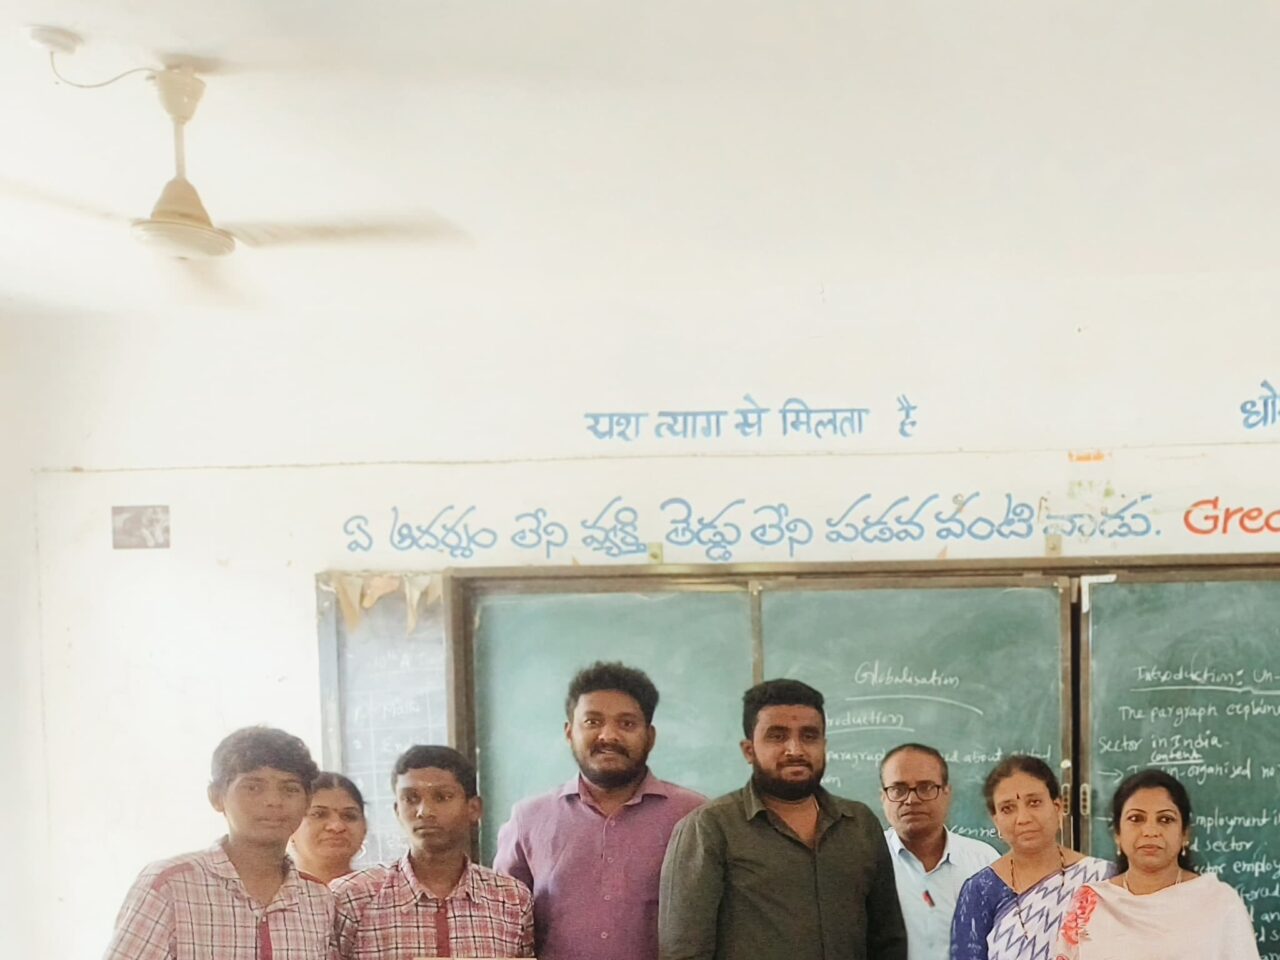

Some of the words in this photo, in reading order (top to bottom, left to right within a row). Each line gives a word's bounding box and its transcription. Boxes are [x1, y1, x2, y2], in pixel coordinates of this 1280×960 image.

[734, 393, 770, 438] से
[778, 397, 870, 439] मिलता
[896, 394, 917, 438] है
[826, 711, 904, 728] roduction
[827, 748, 886, 768] paragrap
